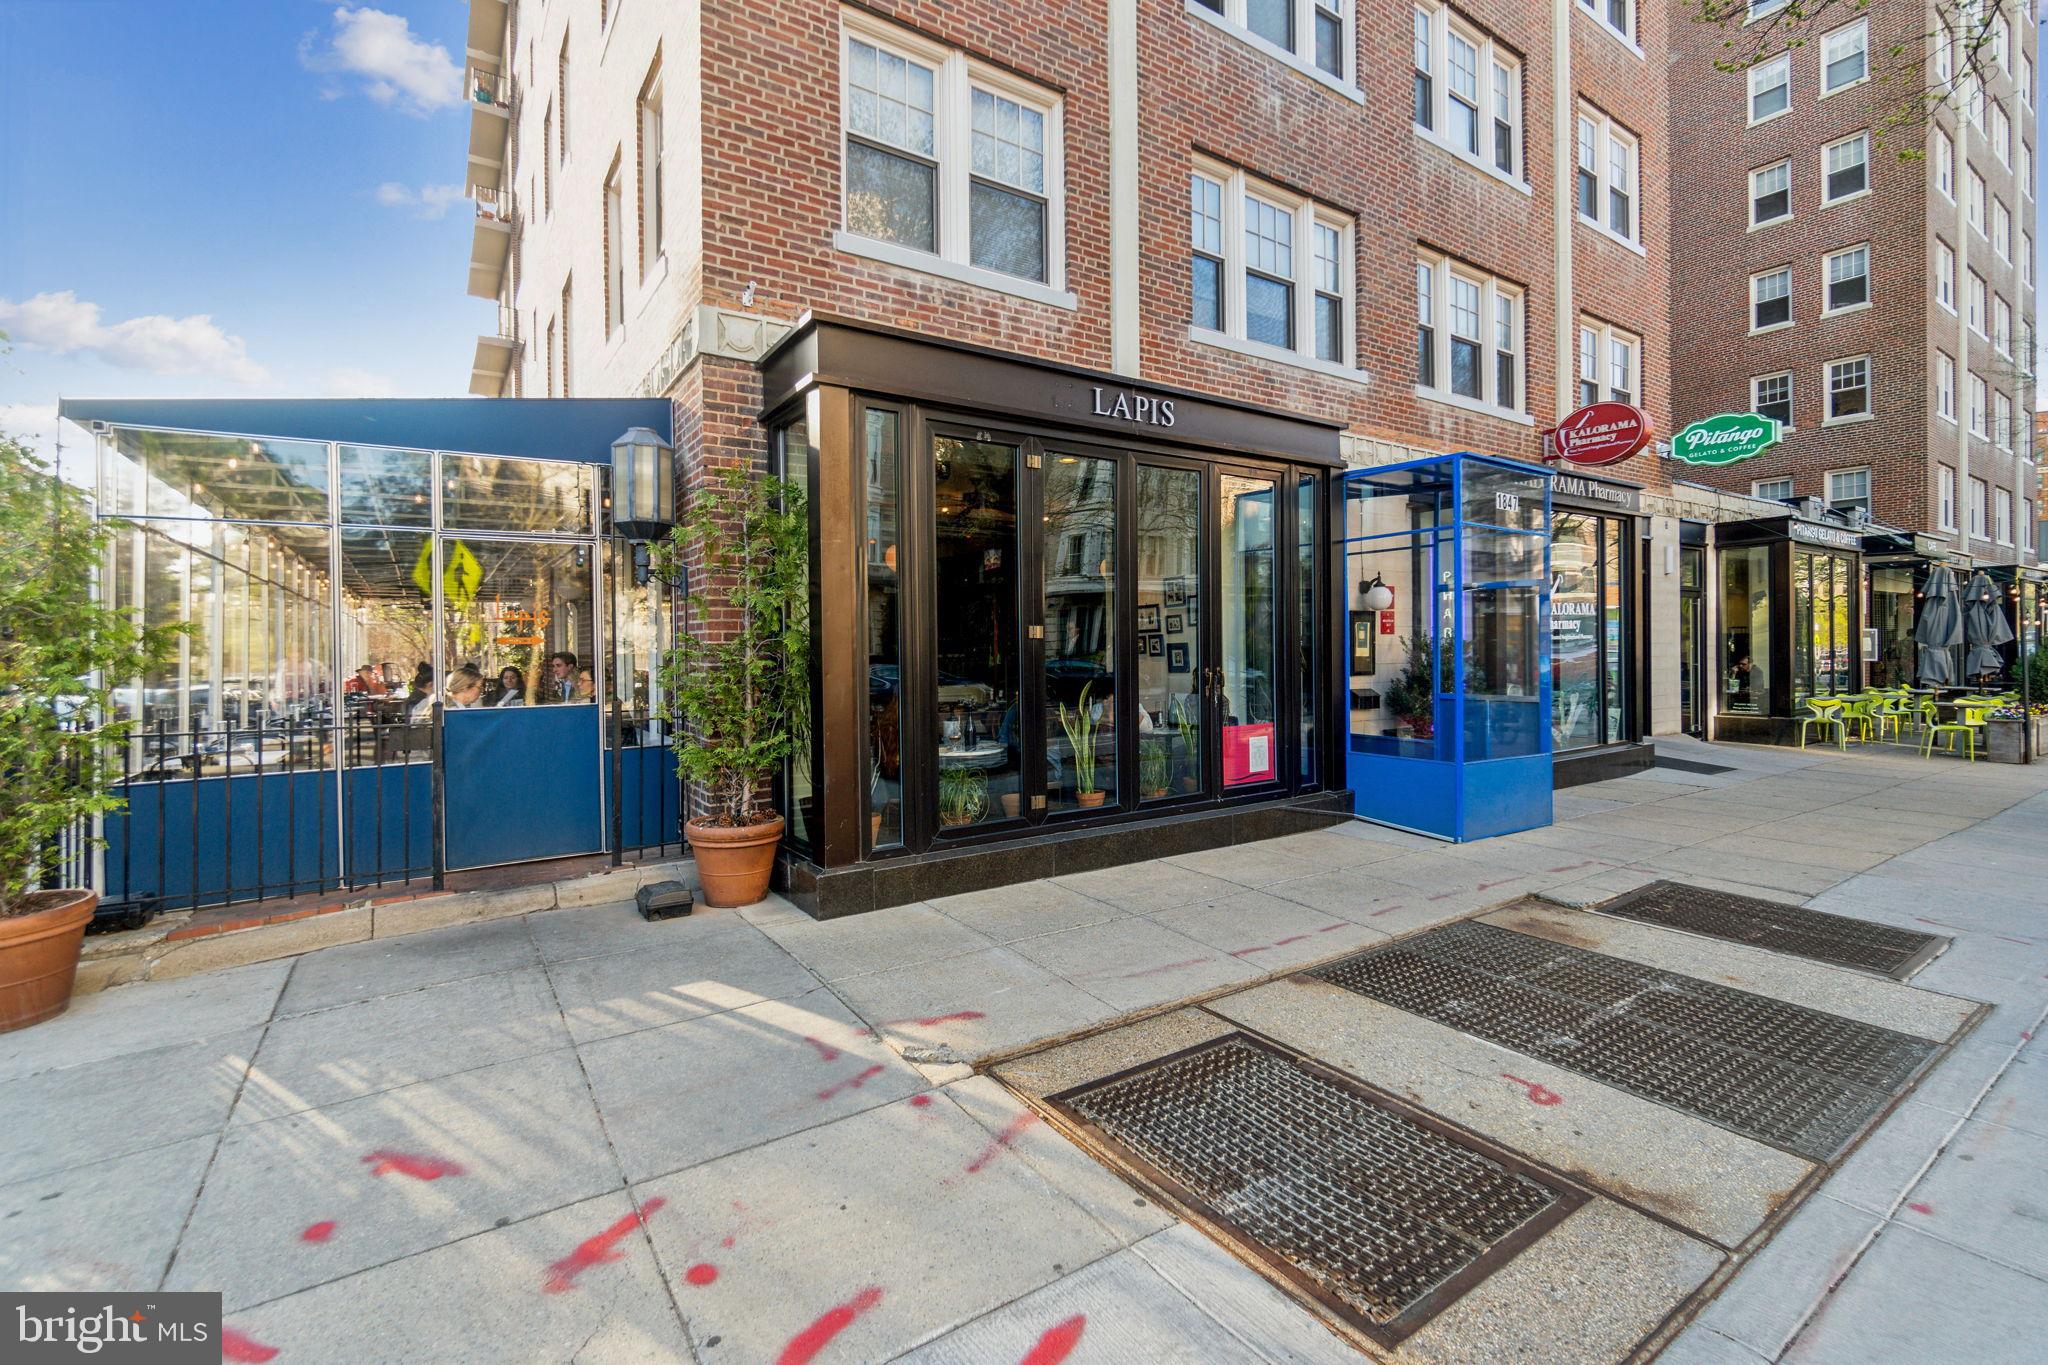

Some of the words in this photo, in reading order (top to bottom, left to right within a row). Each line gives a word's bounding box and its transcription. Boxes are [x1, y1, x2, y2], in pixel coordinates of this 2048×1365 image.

[1093, 386, 1175, 427] LAPIS
[1569, 418, 1639, 439] KALORAMA
[1685, 425, 1764, 450] Pitango
[1569, 432, 1618, 447] Pharmacy
[1688, 449, 1718, 459] GELATO
[1728, 443, 1757, 453] COFFEE
[1497, 493, 1518, 511] 1847
[1588, 480, 1632, 507] Pharmacy
[1551, 602, 1597, 616] ALORAMA
